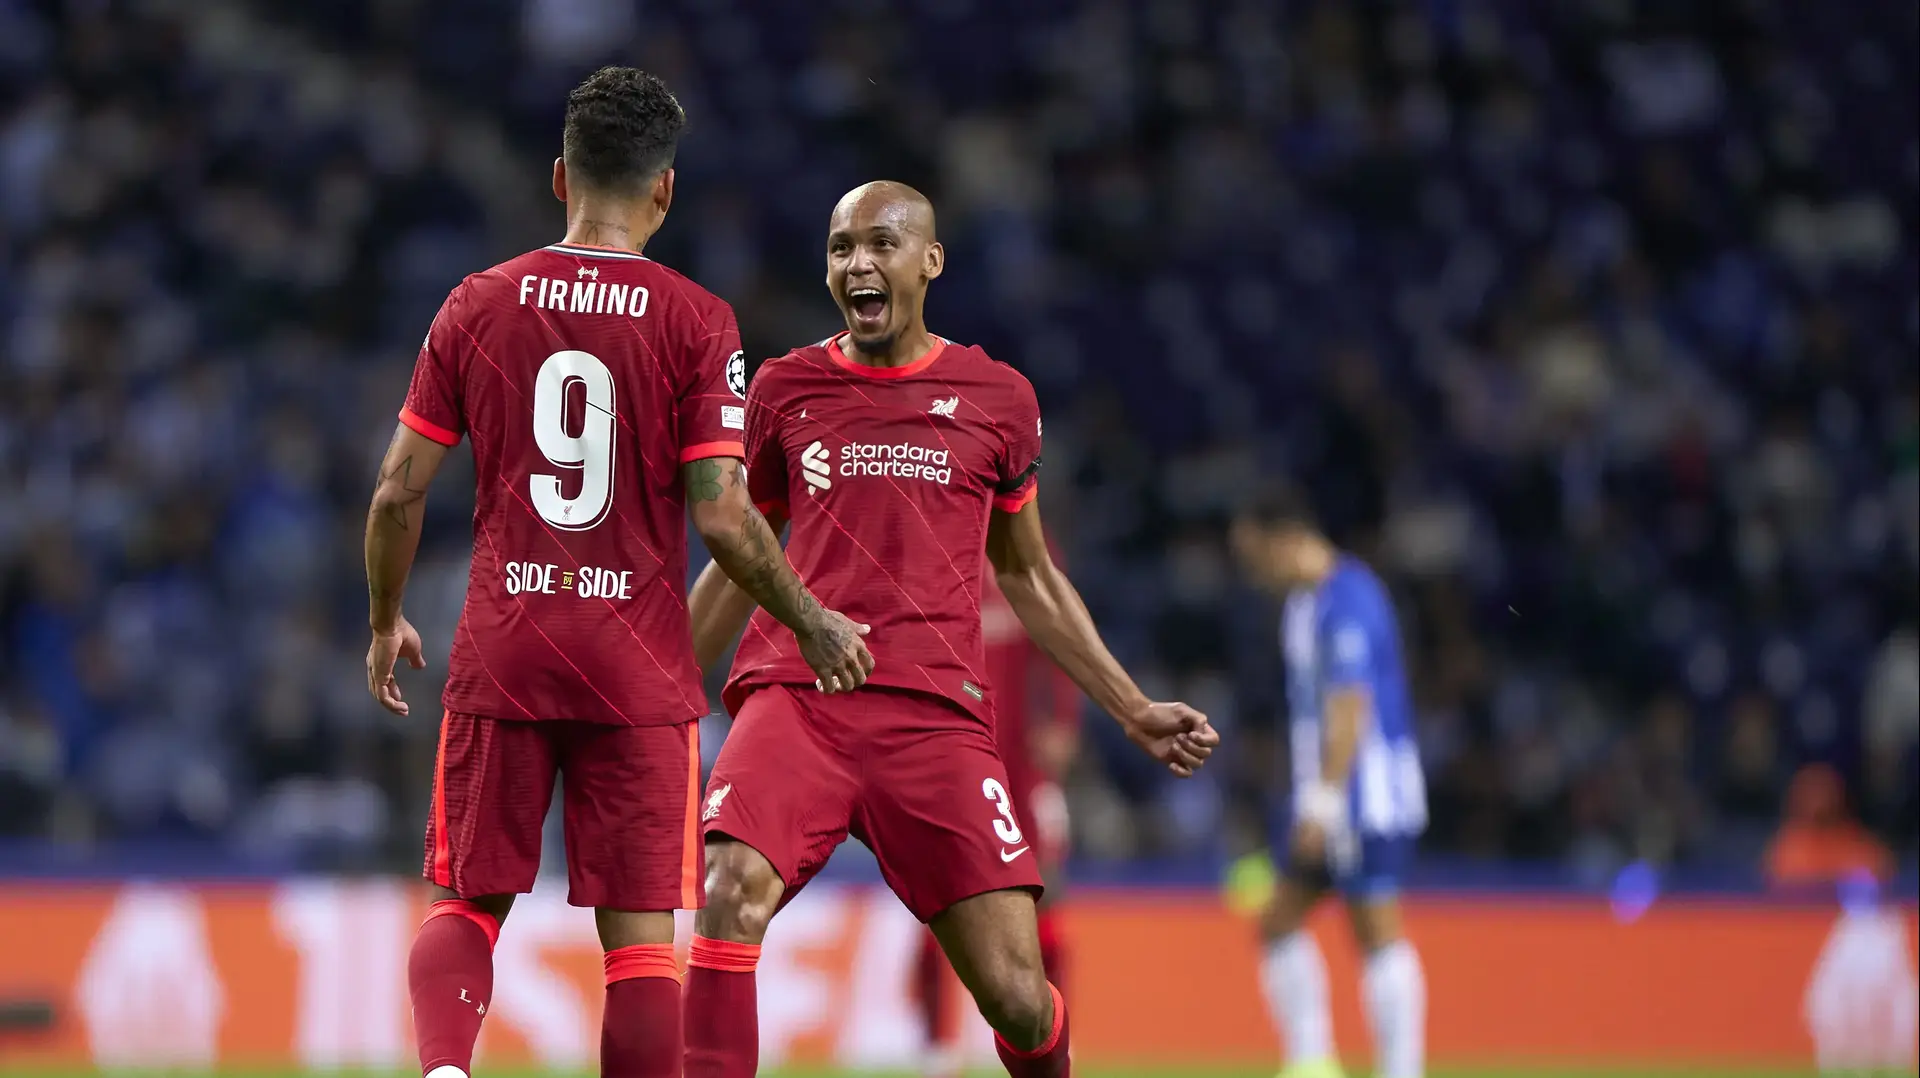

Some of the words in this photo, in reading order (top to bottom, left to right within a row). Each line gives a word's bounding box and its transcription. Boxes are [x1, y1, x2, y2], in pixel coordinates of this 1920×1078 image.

[519, 274, 650, 318] FIRMINO
[529, 349, 617, 532] 9
[840, 441, 949, 466] standard
[839, 458, 952, 485] chartered
[505, 561, 559, 595] SIDE
[577, 566, 634, 600] SIDE
[982, 777, 1023, 845] 3
